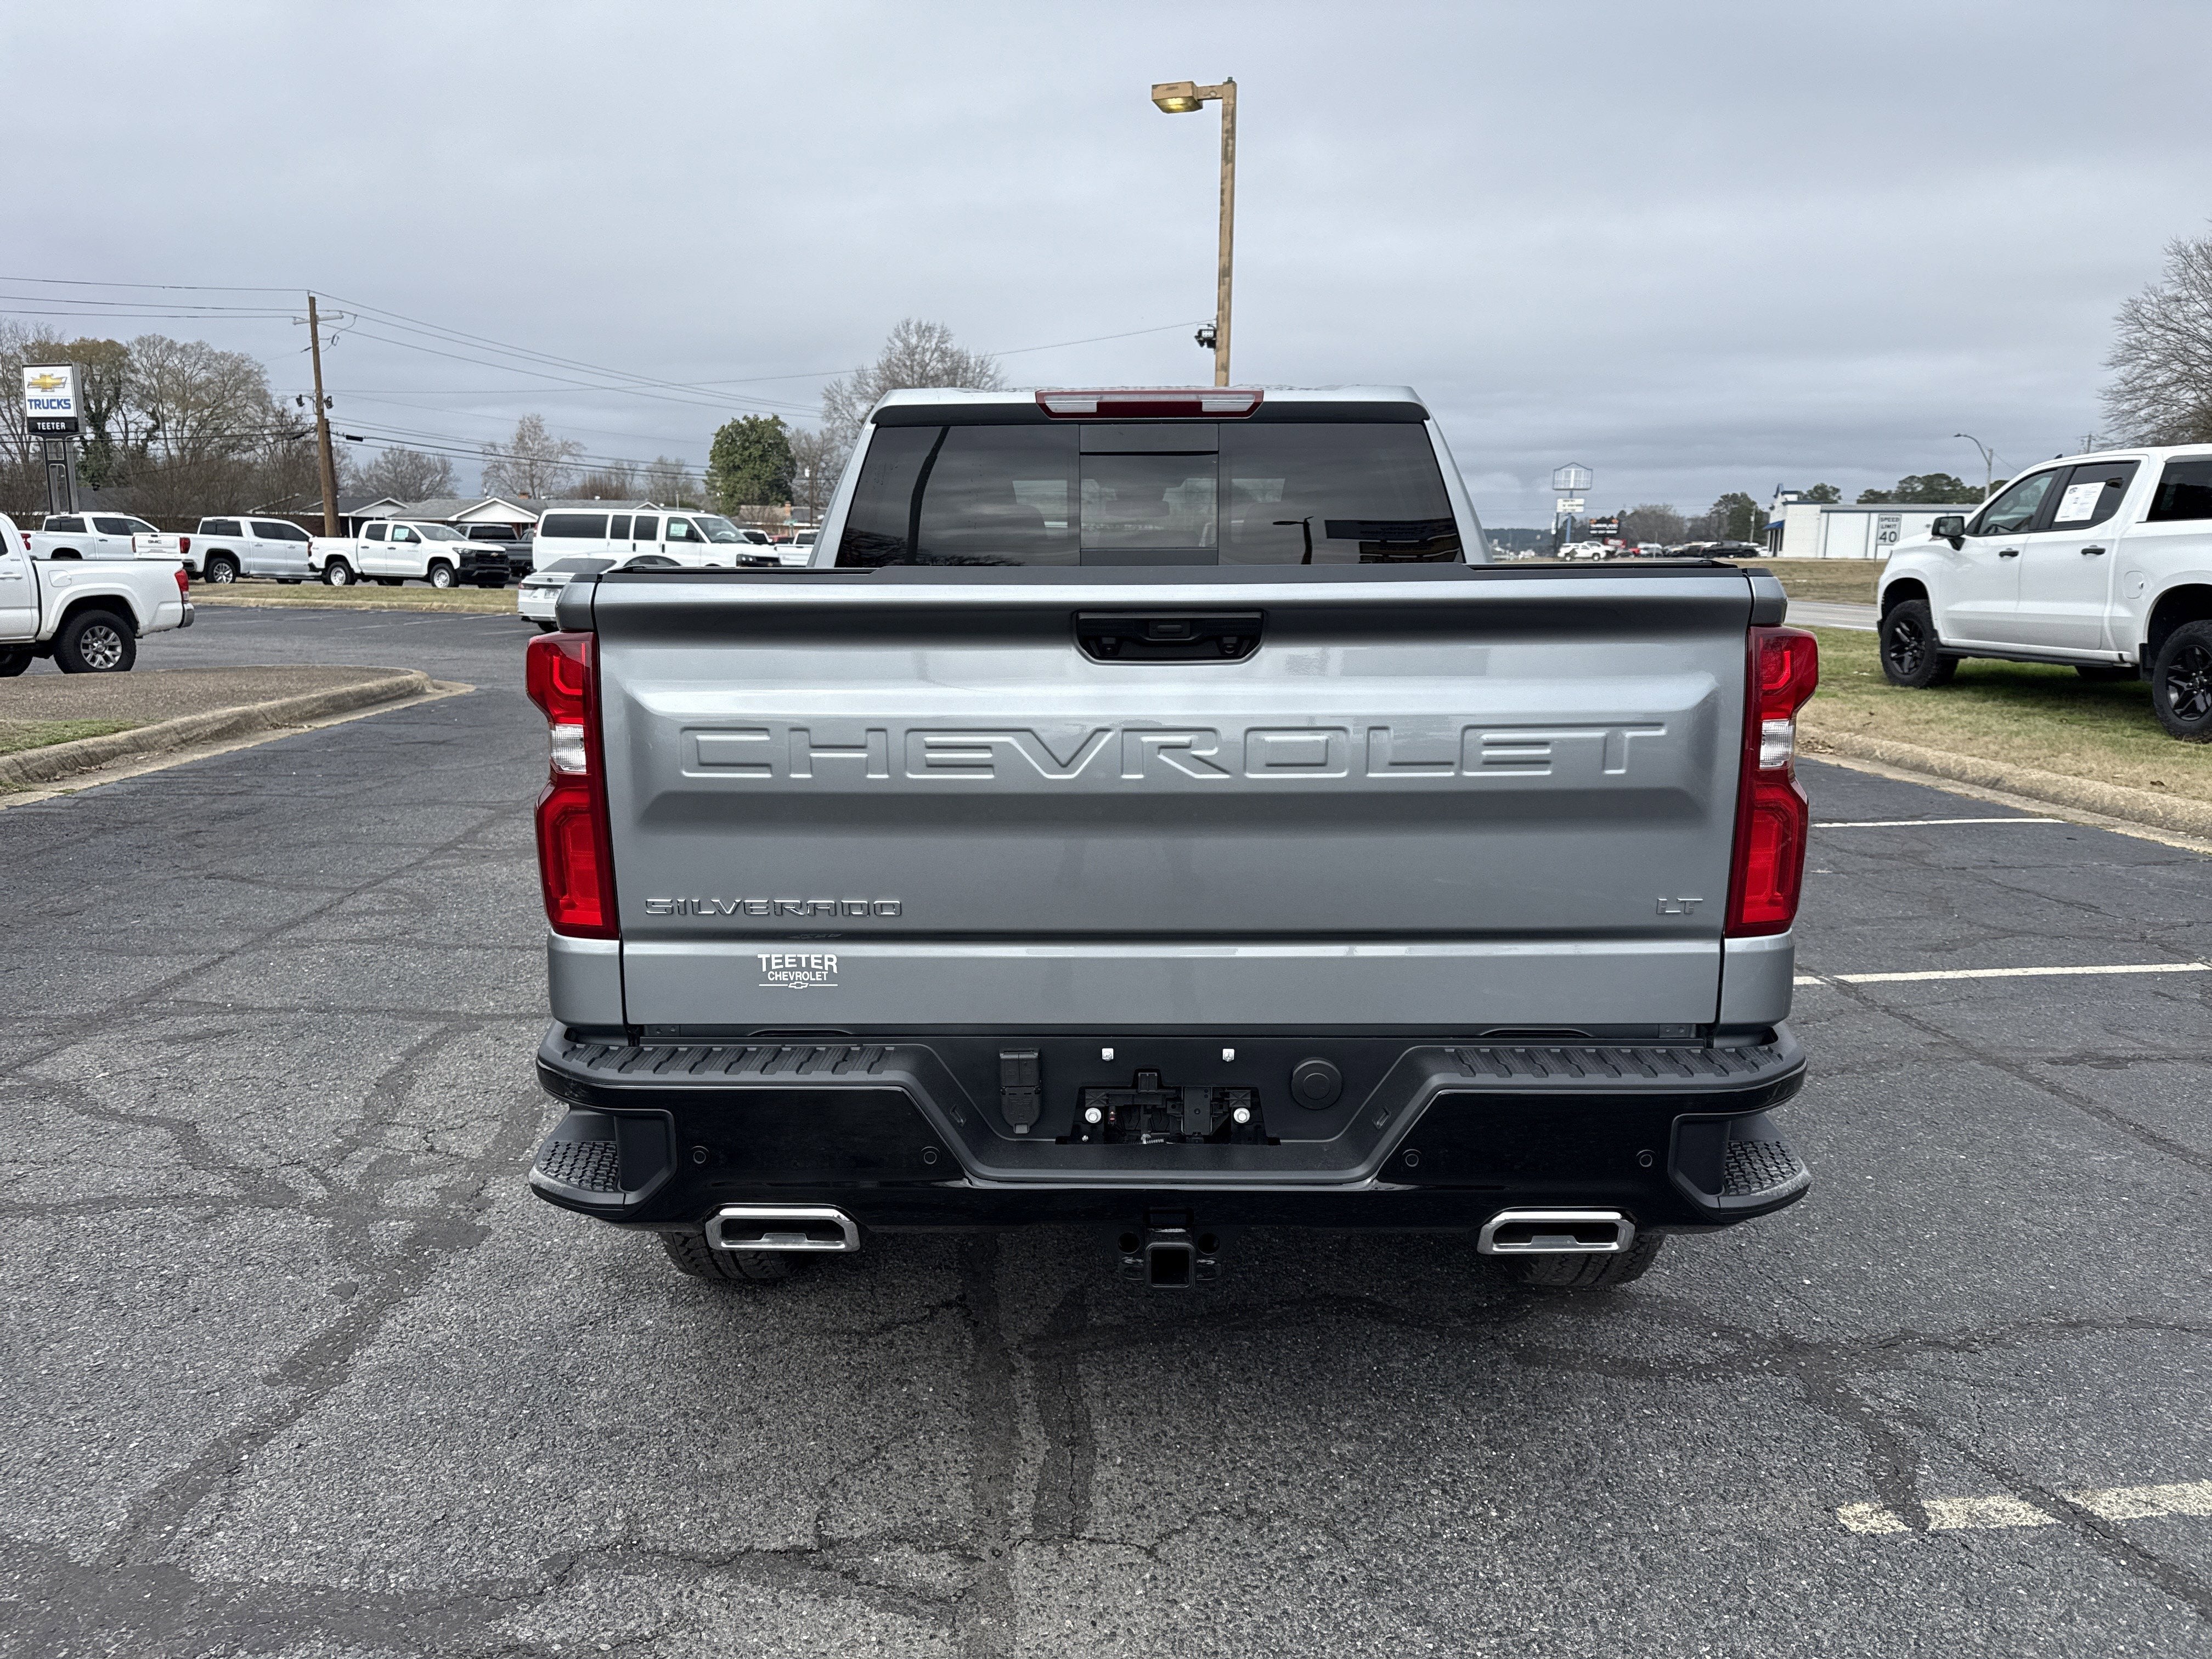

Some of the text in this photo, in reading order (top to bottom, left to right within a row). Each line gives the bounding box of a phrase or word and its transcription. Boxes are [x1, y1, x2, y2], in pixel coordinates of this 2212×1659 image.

[27, 398, 71, 409] TRUCKS
[37, 422, 66, 430] TEETER
[1879, 531, 1897, 543] 40
[680, 722, 1667, 778] CHEVROLET
[645, 898, 902, 917] SILVERADO
[1656, 898, 1703, 915] LT
[758, 953, 838, 974] TEETER
[768, 971, 828, 981] CHEVROLET
